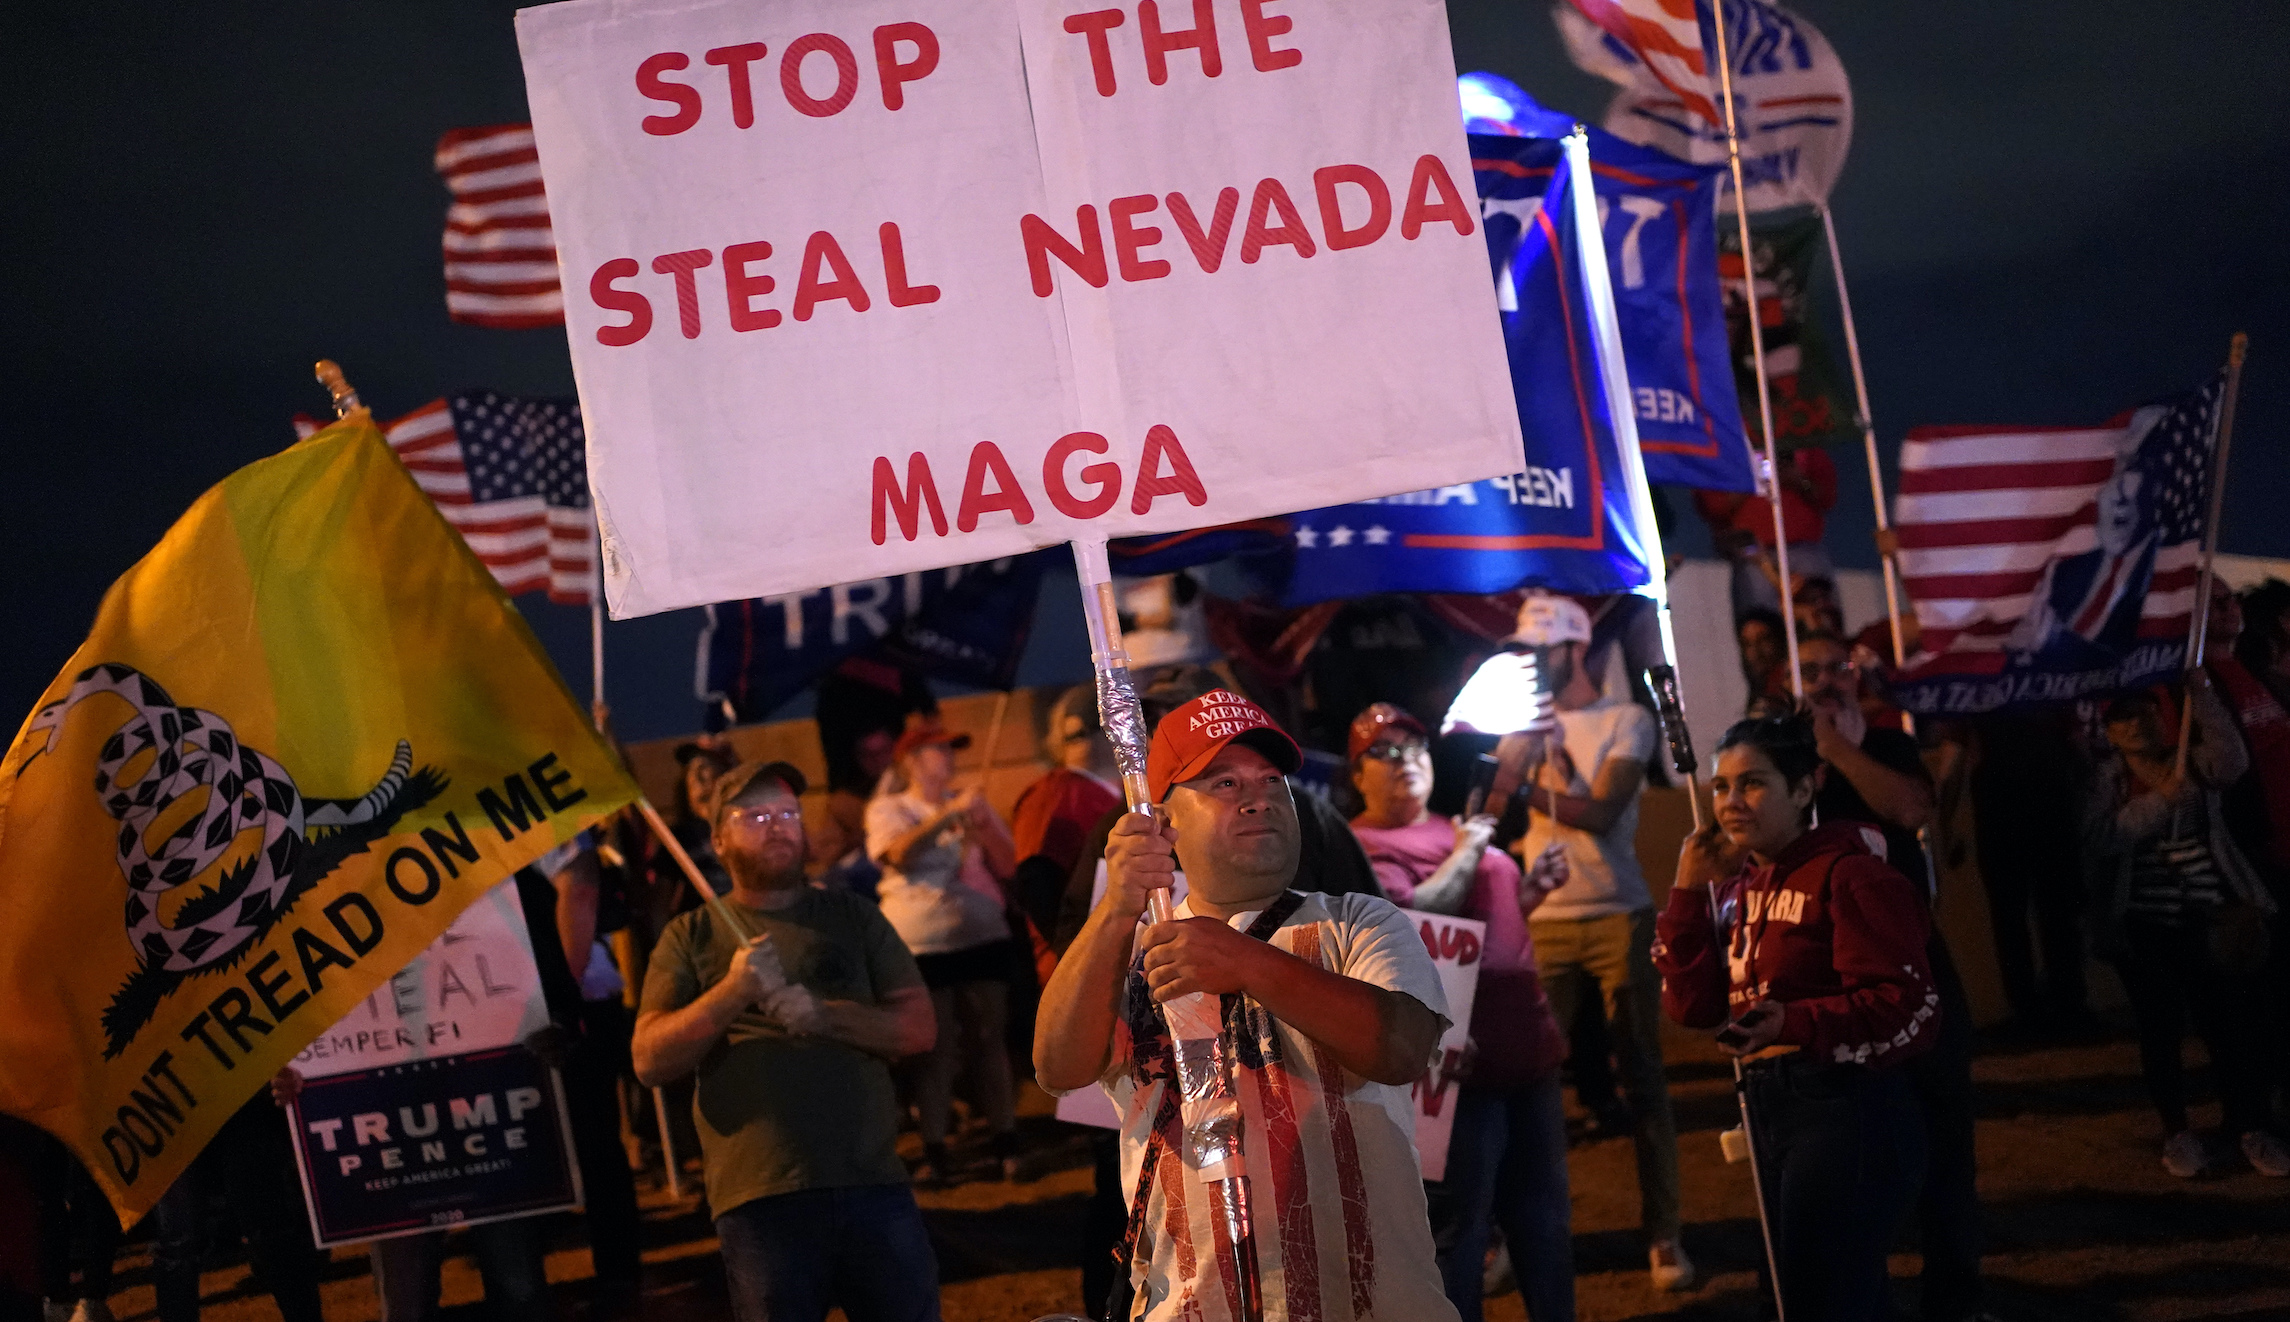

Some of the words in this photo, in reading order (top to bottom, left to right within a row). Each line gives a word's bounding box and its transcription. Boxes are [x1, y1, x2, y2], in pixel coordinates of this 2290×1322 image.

[635, 21, 940, 136] STOP
[1062, 0, 1303, 97] THE
[589, 221, 941, 346] STEAL
[1019, 153, 1475, 298] NEVADA
[870, 423, 1208, 545] MAGA
[1189, 705, 1269, 731] AMERICA
[1199, 691, 1247, 708] KEEP
[1205, 719, 1256, 738] GRE
[1420, 920, 1480, 966] AUD
[102, 1050, 198, 1187] DONT
[180, 891, 384, 1071] TREAD
[385, 811, 481, 905] ON
[476, 751, 588, 842] ME
[308, 1086, 542, 1152] TRUMP
[338, 1127, 528, 1177] PENCE
[364, 1175, 400, 1191] KEEP
[402, 1167, 462, 1185] AMERICA
